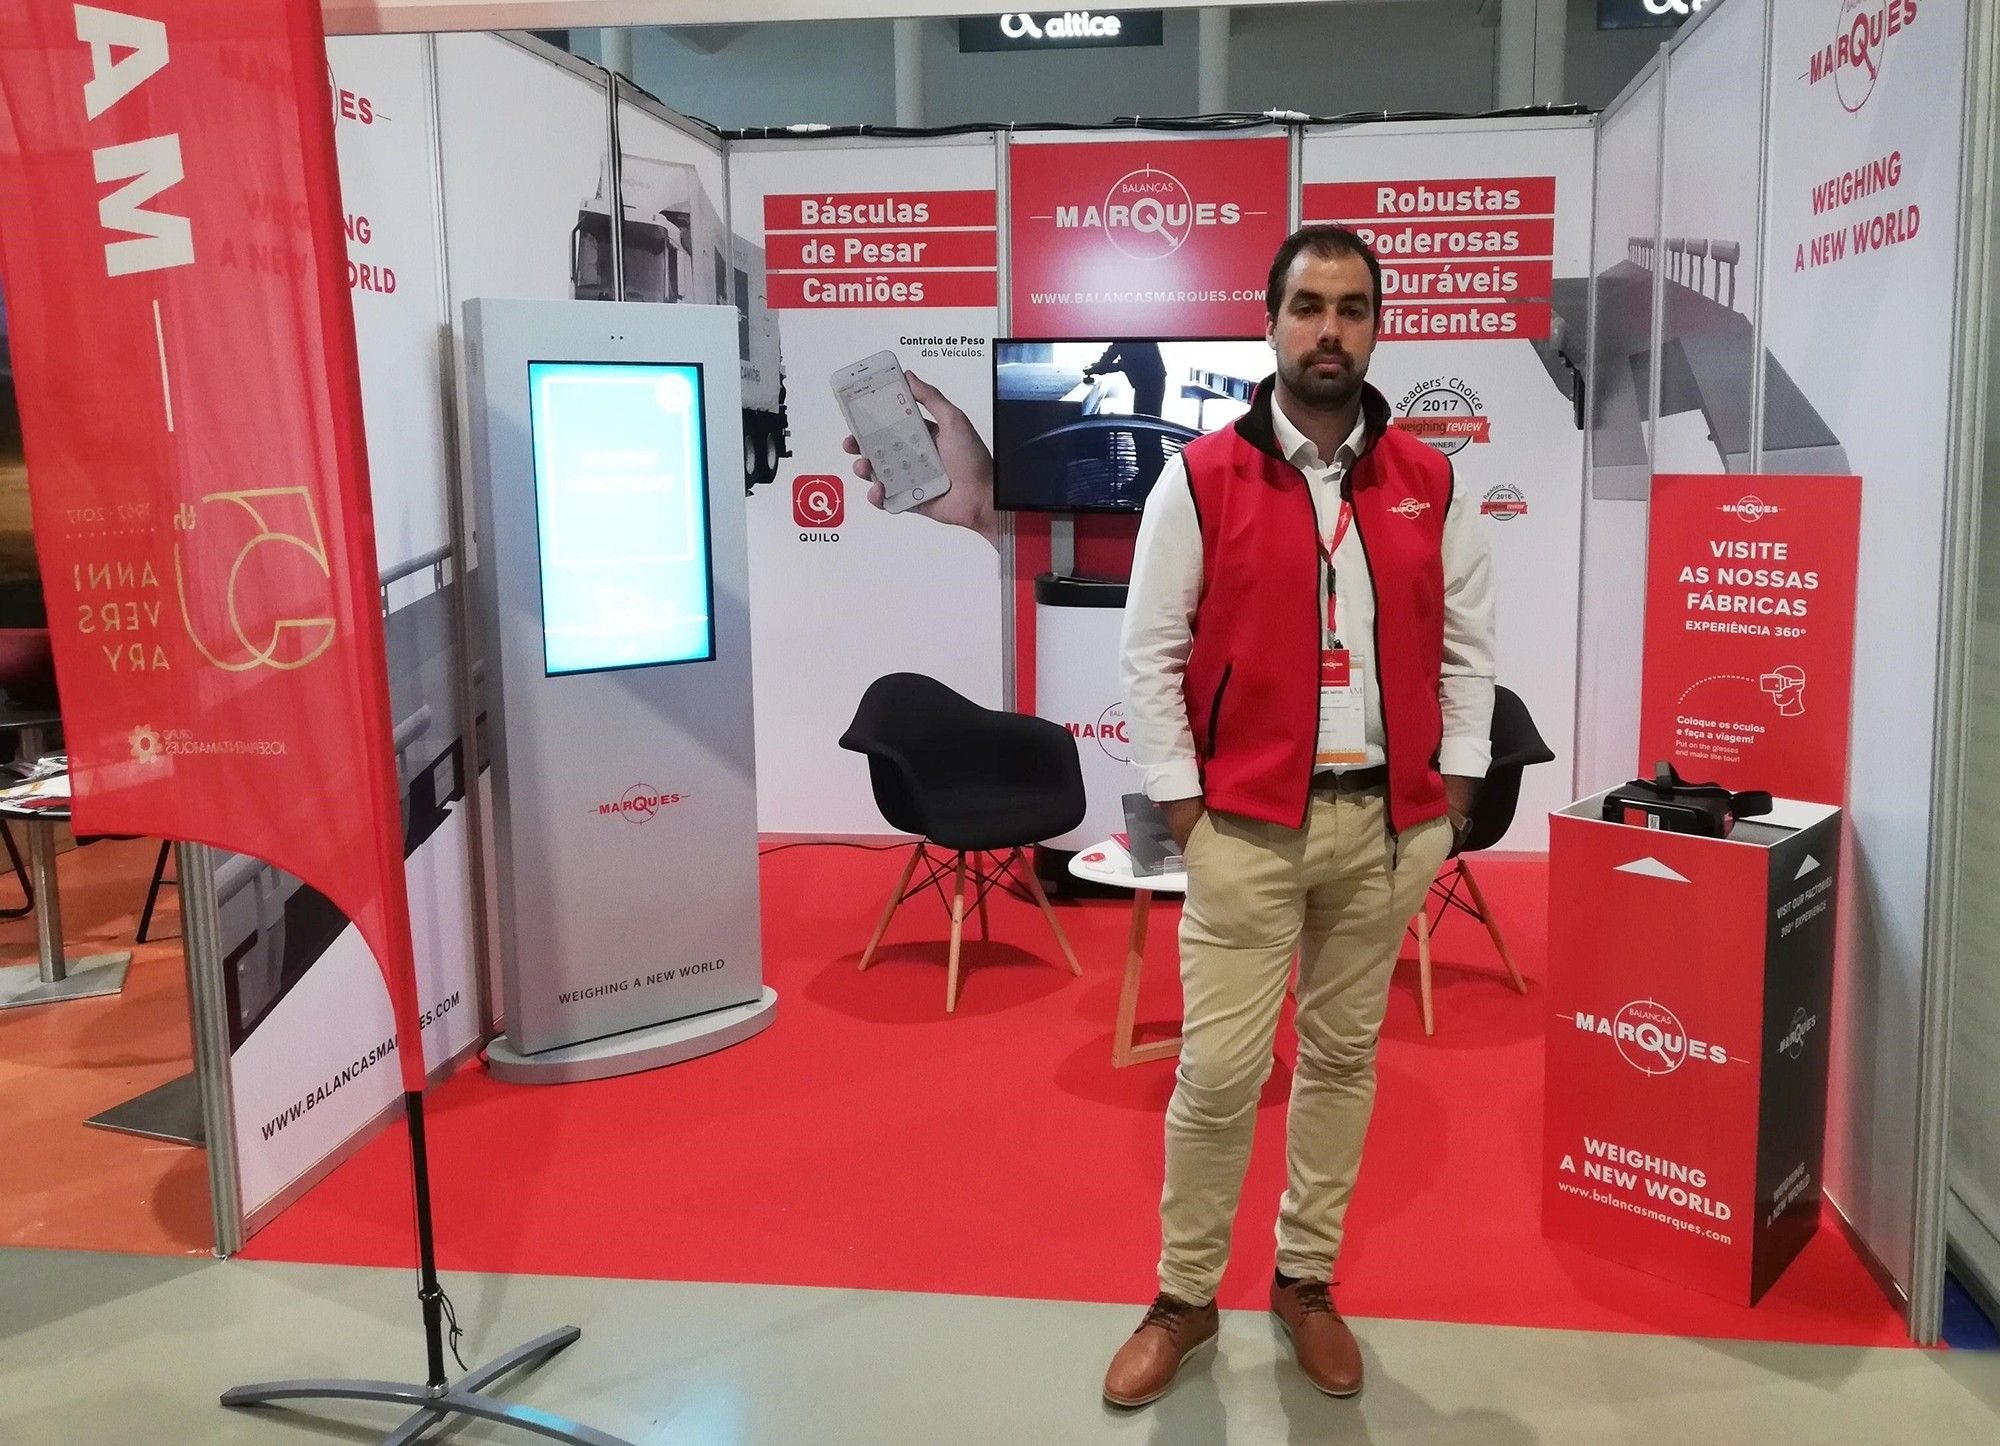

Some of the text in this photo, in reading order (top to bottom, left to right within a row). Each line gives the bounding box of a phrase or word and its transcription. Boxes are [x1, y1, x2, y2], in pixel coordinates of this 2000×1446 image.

[1045, 12, 1121, 37] altice
[1812, 150, 1902, 216] WEIGHING
[801, 197, 929, 225] Básculas
[1376, 186, 1521, 214] Robustas
[1056, 197, 1241, 247] MARQUES
[802, 238, 927, 264] de Pesar
[1356, 227, 1520, 255] Poderosas
[1795, 204, 1921, 273] A NEW WORLD
[803, 276, 924, 303] Camiões
[1381, 265, 1518, 293] Duráveis
[1379, 308, 1517, 334] ficientes
[900, 336, 985, 346] Controlo de Peso
[921, 347, 985, 357] dos Veículos.
[1422, 400, 1458, 412] 2017
[1449, 377, 1483, 410] Choice
[1722, 503, 1779, 518] MARQUES
[799, 533, 840, 543] QUILO
[1710, 540, 1788, 561] VISITE
[1678, 566, 1819, 590] AS NOSSAS
[1687, 590, 1807, 617] FÁBRICAS
[1685, 619, 1771, 636] EXPERIÊNCIA
[1677, 715, 1717, 728] Coloque
[1732, 721, 1765, 733] óculos
[1684, 728, 1705, 739] faça
[1715, 732, 1754, 744] viagem!
[599, 793, 680, 816] MARQUES
[559, 959, 725, 1004] WEIGHING A NEW WORLD
[1576, 1011, 1728, 1069] MARQUES
[1584, 1136, 1707, 1188] WEIGHING
[1559, 1155, 1732, 1221] A NEW WORLD
[1558, 1181, 1732, 1245] www.balancasmarques.com
